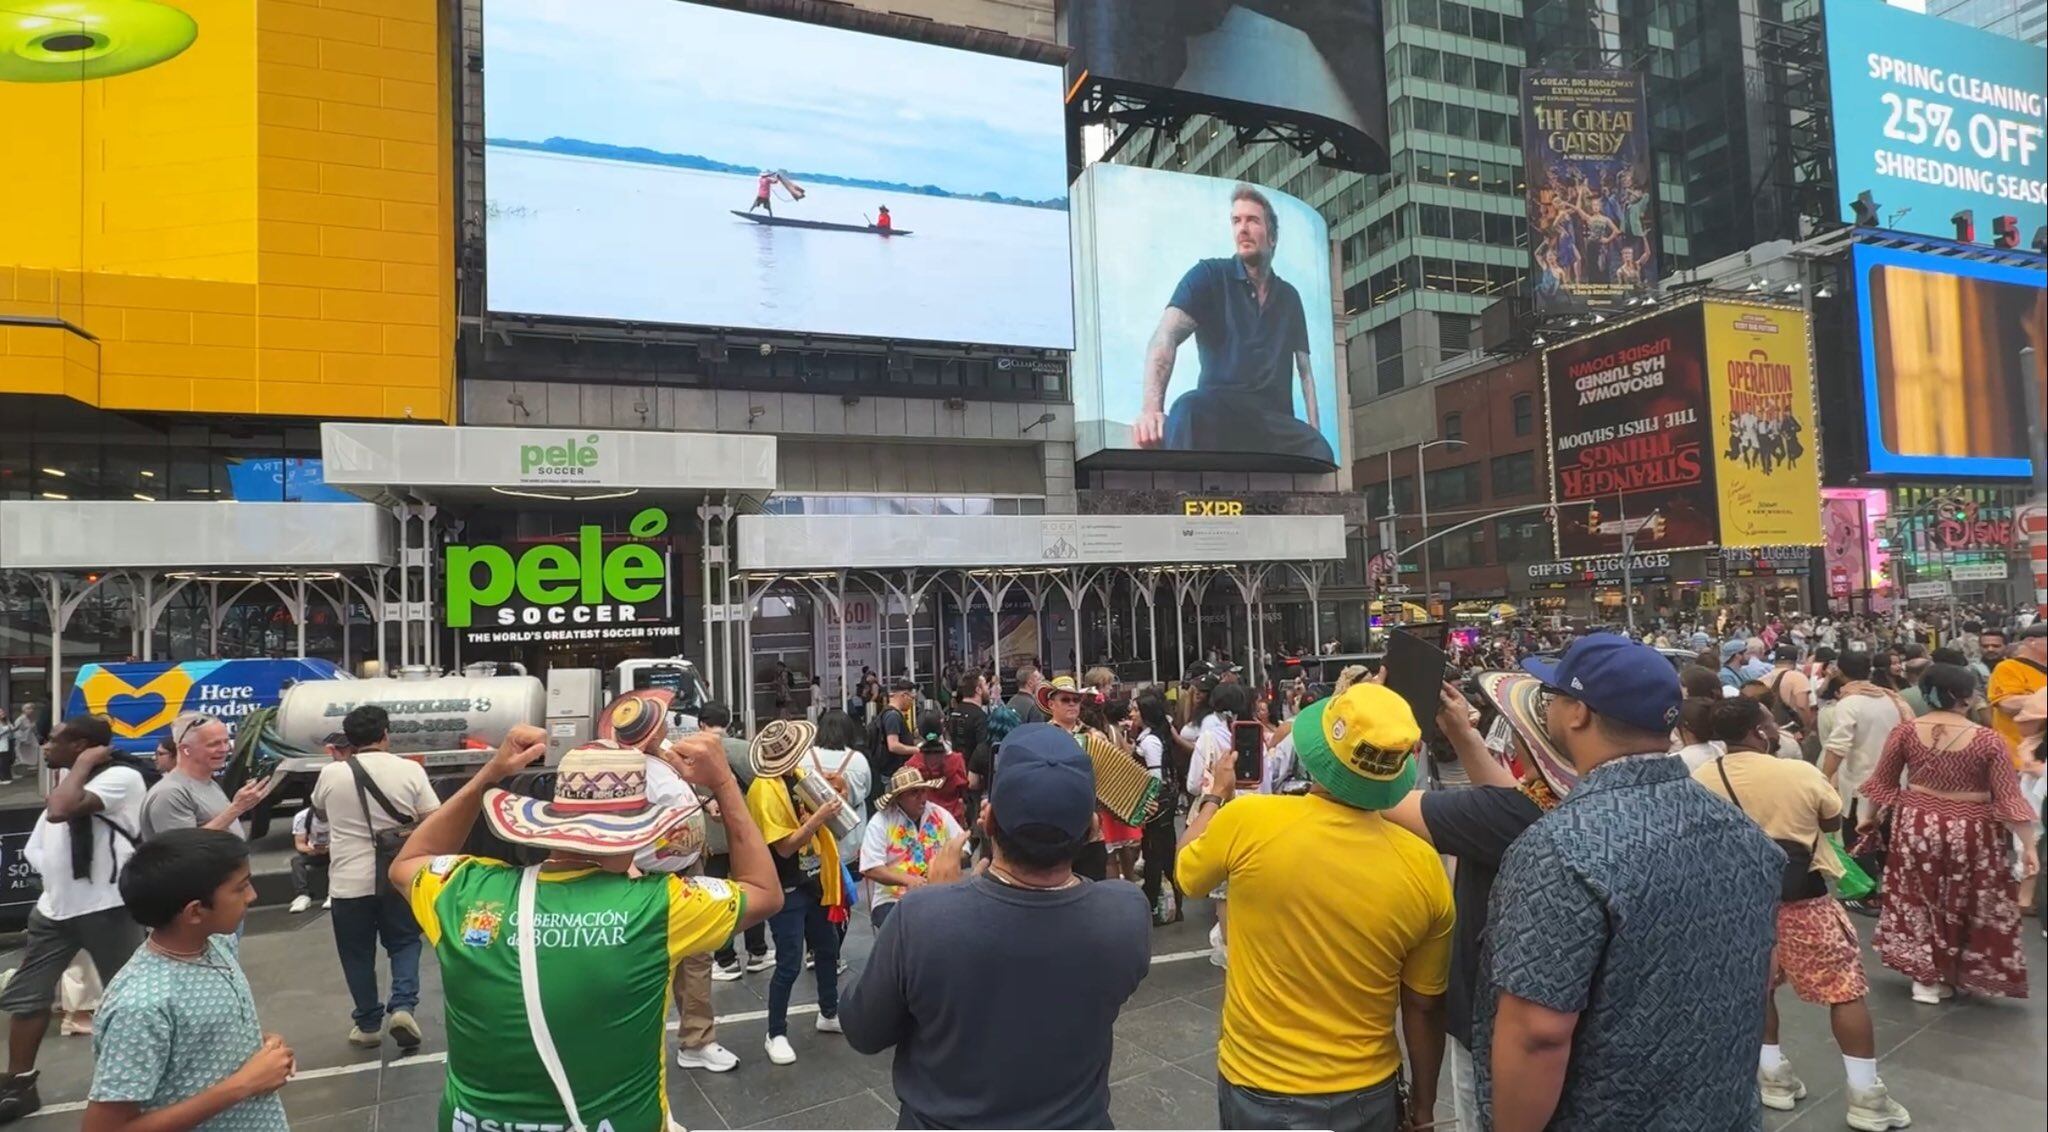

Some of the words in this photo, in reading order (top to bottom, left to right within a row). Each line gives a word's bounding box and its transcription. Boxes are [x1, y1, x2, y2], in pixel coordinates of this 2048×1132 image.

[1867, 53, 1944, 94] SPRING
[1948, 73, 2041, 117] CLEANING
[1536, 108, 1568, 130] THE
[1573, 109, 1634, 132] GREAT
[1881, 92, 1961, 152] 25%
[1548, 132, 1625, 154] GATSBY
[1874, 149, 1994, 195] SHREDDING
[1618, 337, 1671, 364] UPSIDE
[1569, 355, 1614, 378] DOWN
[1632, 355, 1665, 372] HAS
[1575, 366, 1631, 391] TURNED
[1578, 371, 1664, 406] BROADWAY
[1728, 360, 1792, 394] OPERATION
[1617, 416, 1659, 438] FIRST
[1664, 408, 1697, 429] THE
[1558, 425, 1614, 451] SHADOW
[520, 434, 599, 474] pelé
[1579, 433, 1674, 470] THINGS
[538, 466, 585, 476] SOCCER
[1560, 448, 1700, 498] STRANGER
[446, 508, 669, 628] pelé
[1528, 561, 1573, 577] GIFTS
[1585, 554, 1670, 573] LUGGAGE
[498, 604, 636, 626] SOCCER
[467, 633, 490, 643] THE
[492, 630, 542, 642] WORLD'S
[543, 628, 600, 640] GREATEST
[602, 627, 644, 639] SOCCER
[646, 626, 681, 636] STORE
[201, 684, 254, 700] Here
[533, 924, 627, 948] BOLÍVAR
